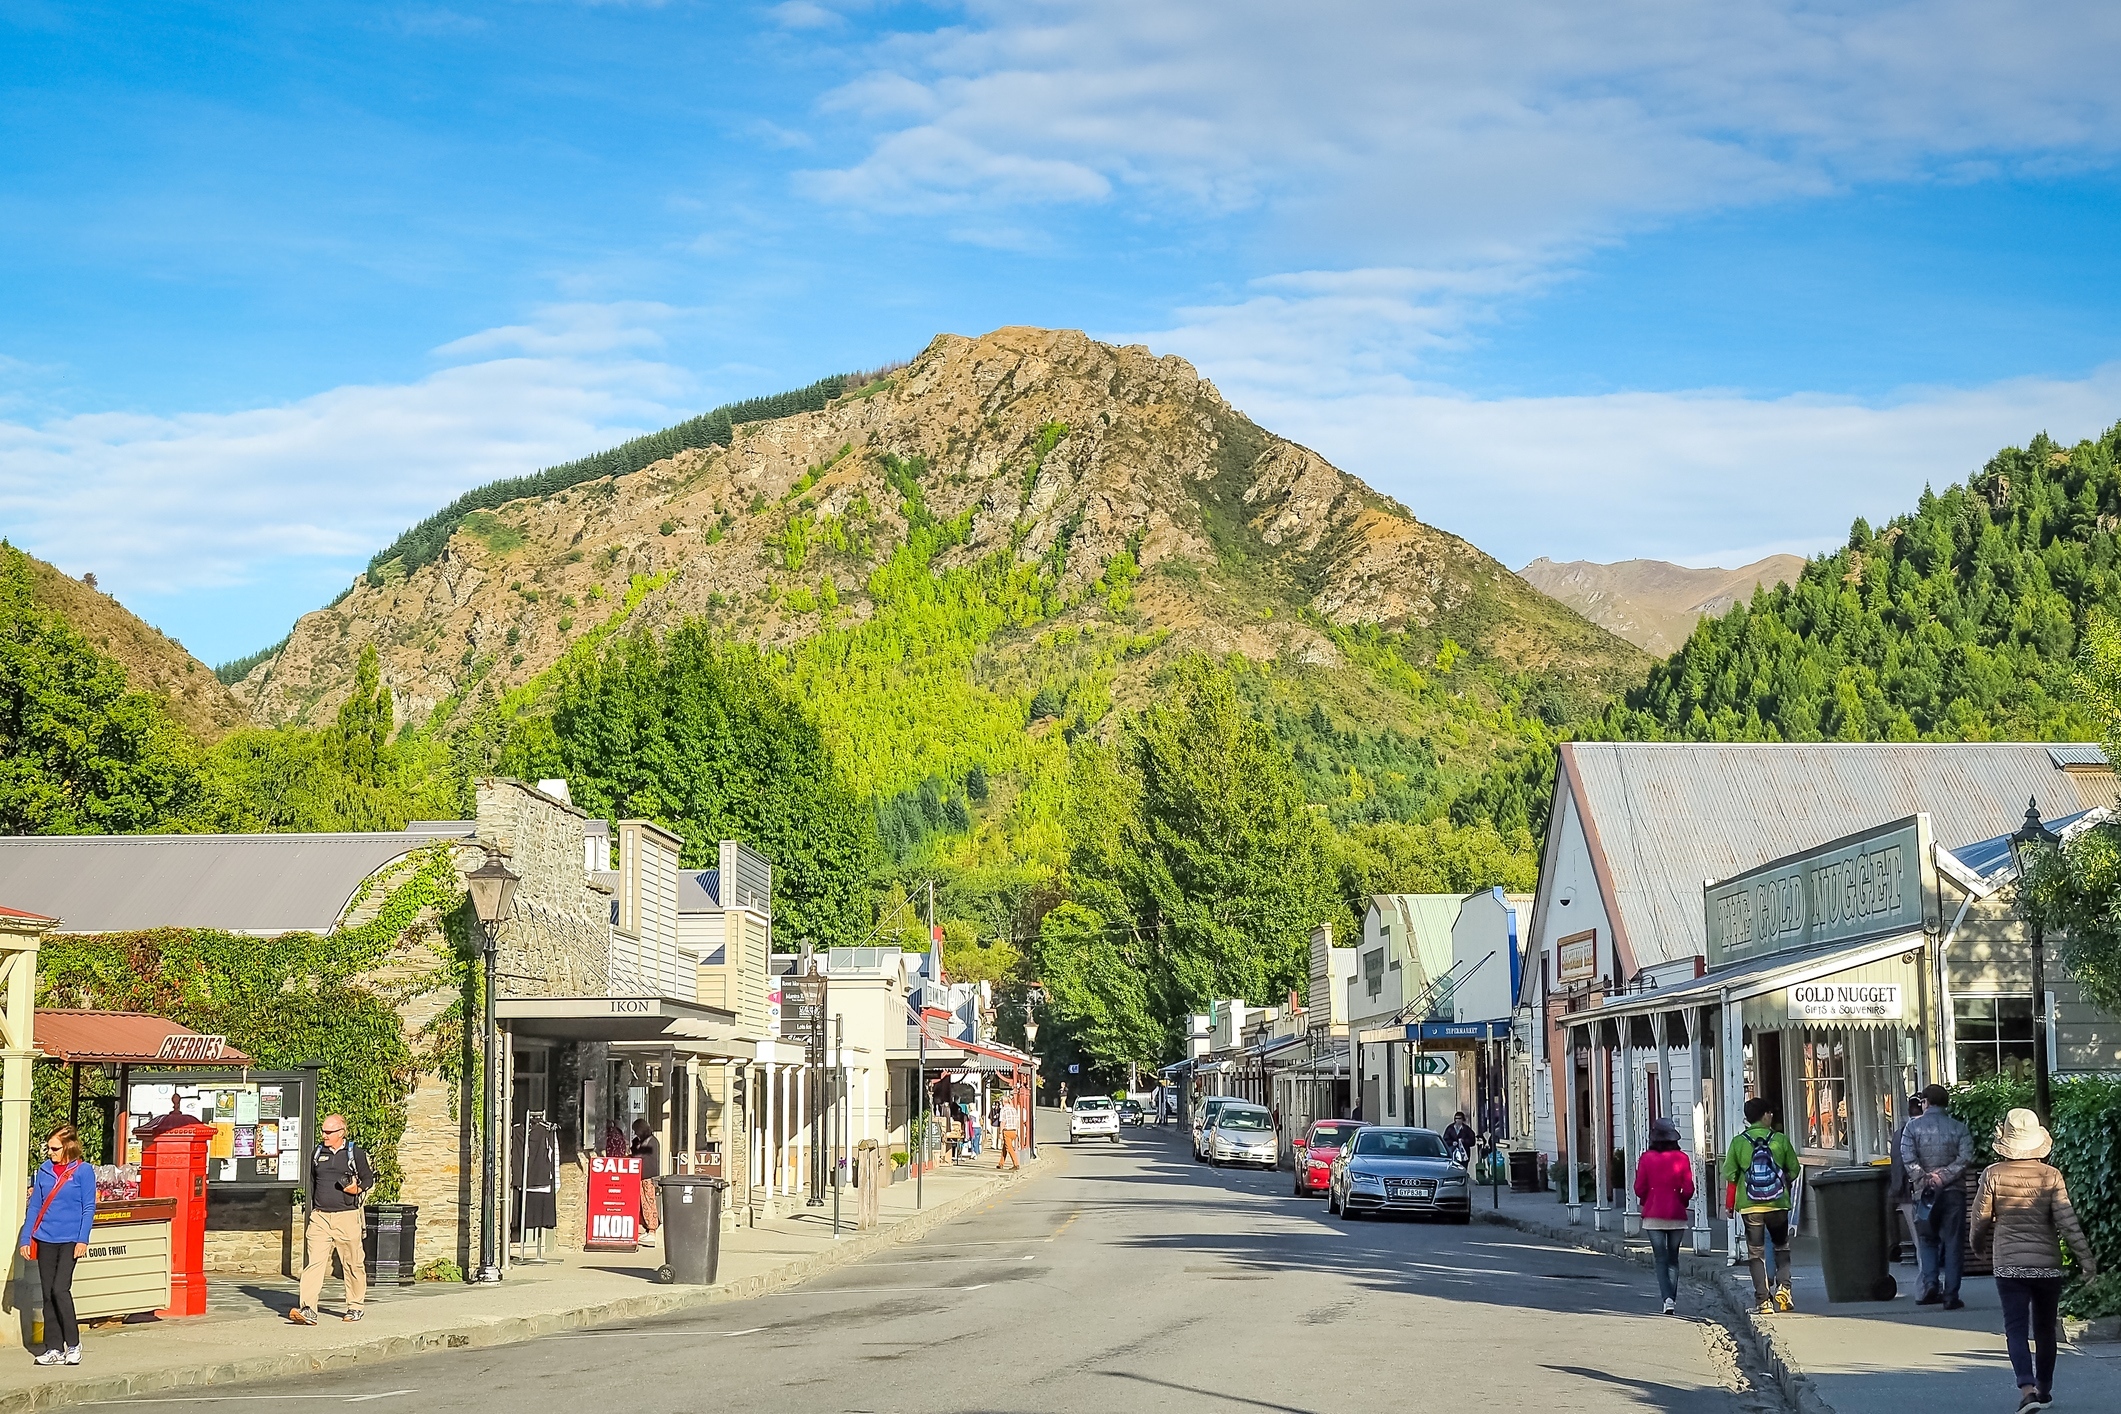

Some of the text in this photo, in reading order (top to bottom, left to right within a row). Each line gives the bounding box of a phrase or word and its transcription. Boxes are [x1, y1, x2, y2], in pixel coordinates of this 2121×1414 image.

[1716, 844, 1903, 951] THE GOLD NUGGET
[1795, 986, 1897, 1003] GOLD NUGGET
[610, 1001, 649, 1012] IKON
[1804, 1004, 1886, 1016] GIFTS & SOUVENIRS
[1445, 1027, 1478, 1035] SUPERMARKET
[160, 1036, 223, 1060] CHERRIES
[591, 1158, 640, 1174] SALE
[88, 1246, 107, 1258] GOOD
[108, 1245, 127, 1256] FRUIT
